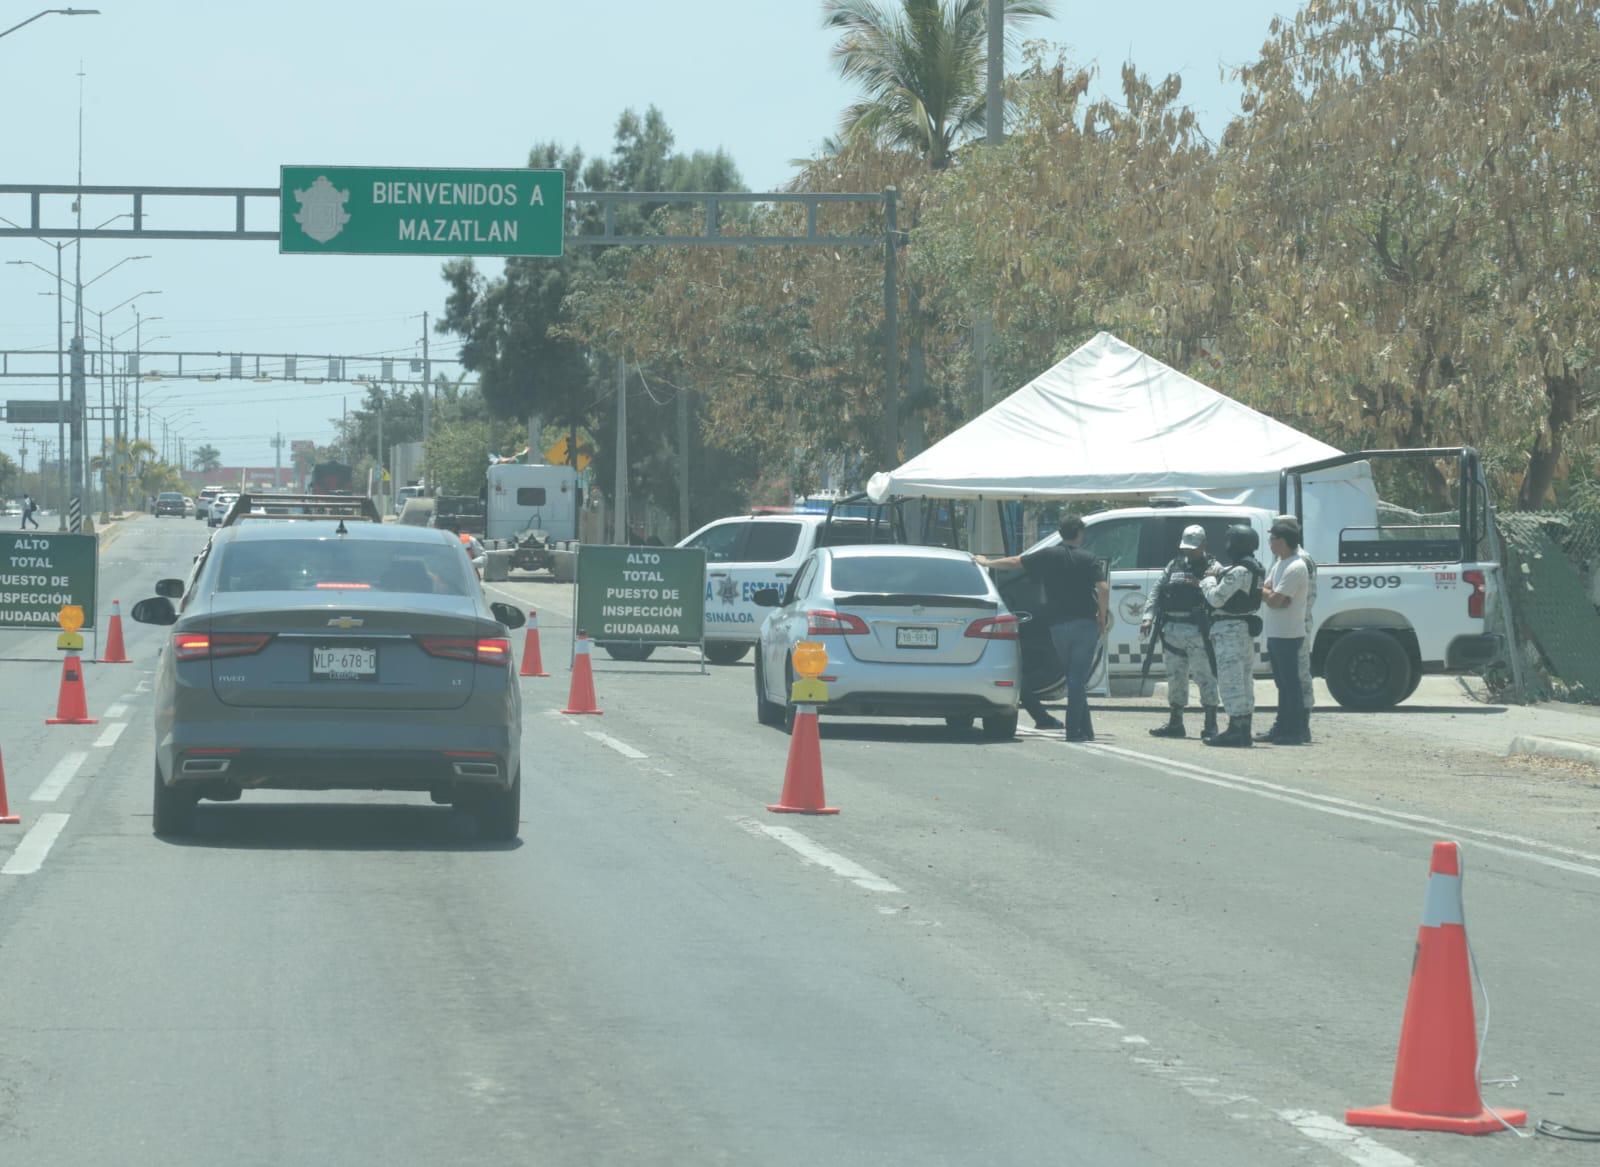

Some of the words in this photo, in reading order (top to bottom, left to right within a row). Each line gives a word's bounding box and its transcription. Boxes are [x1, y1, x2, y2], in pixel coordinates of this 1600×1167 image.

[372, 181, 518, 206] BIENVENIDOS
[529, 184, 544, 206] A
[398, 218, 519, 242] MAZATLAN
[14, 540, 50, 550] ALTO
[10, 557, 53, 568] TOTAL
[626, 553, 661, 565] ALTO
[51, 576, 70, 587] DE
[622, 570, 665, 582] TOTAL
[1330, 575, 1402, 590] 28909
[606, 587, 658, 600] PUESTO
[662, 589, 680, 600] DE
[0, 611, 60, 622] IUDADAN
[602, 604, 683, 618] INSPECCIÓN
[705, 612, 754, 623] SINALOA
[603, 623, 680, 636] CIUDADANA
[313, 653, 376, 670] VLP-678-D
